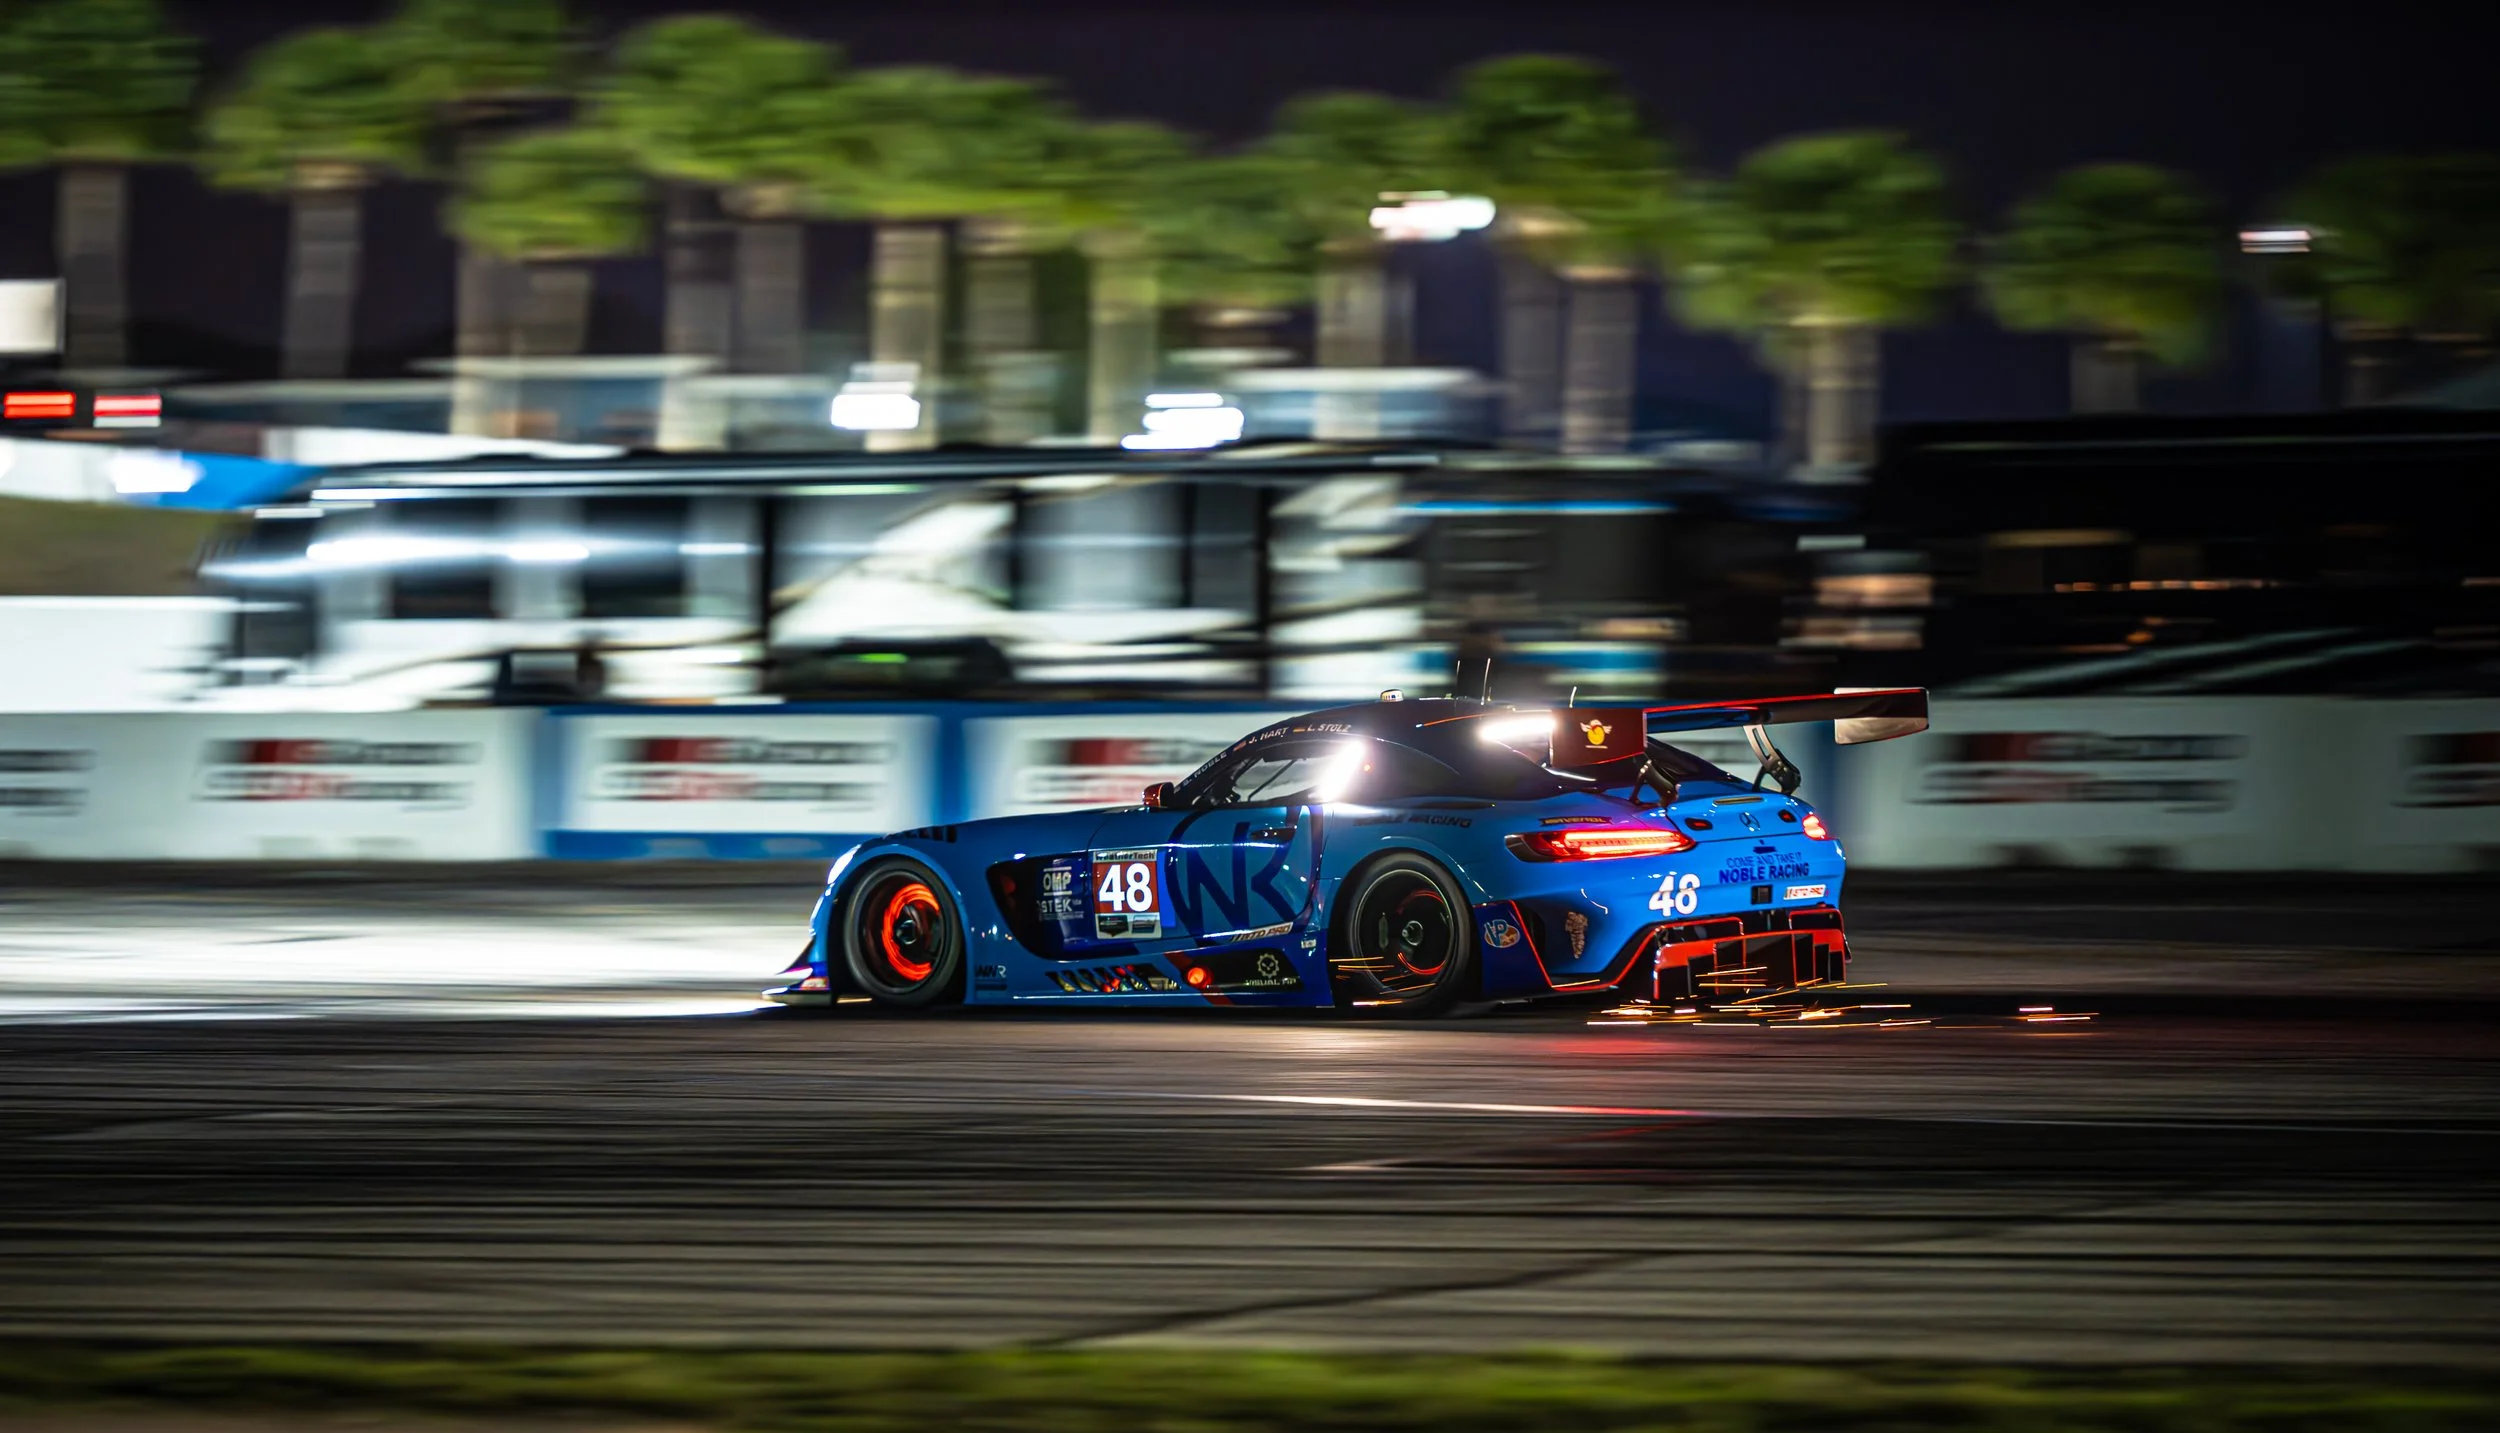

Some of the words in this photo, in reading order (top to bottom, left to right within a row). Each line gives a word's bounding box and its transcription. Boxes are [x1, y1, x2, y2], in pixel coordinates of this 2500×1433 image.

[1248, 736, 1258, 745] J.
[1260, 727, 1288, 741] HART
[1307, 723, 1315, 733] L.
[1317, 723, 1352, 733] STOLZ
[1727, 857, 1751, 869] COME
[1757, 853, 1775, 866] AND
[1776, 852, 1796, 864] TAKE
[1043, 871, 1073, 892] OMP
[1719, 866, 1766, 884] NOBLE
[1769, 862, 1810, 879] RACING
[1099, 863, 1153, 912] 48
[1648, 873, 1701, 917] 48
[1484, 919, 1509, 948] VP
